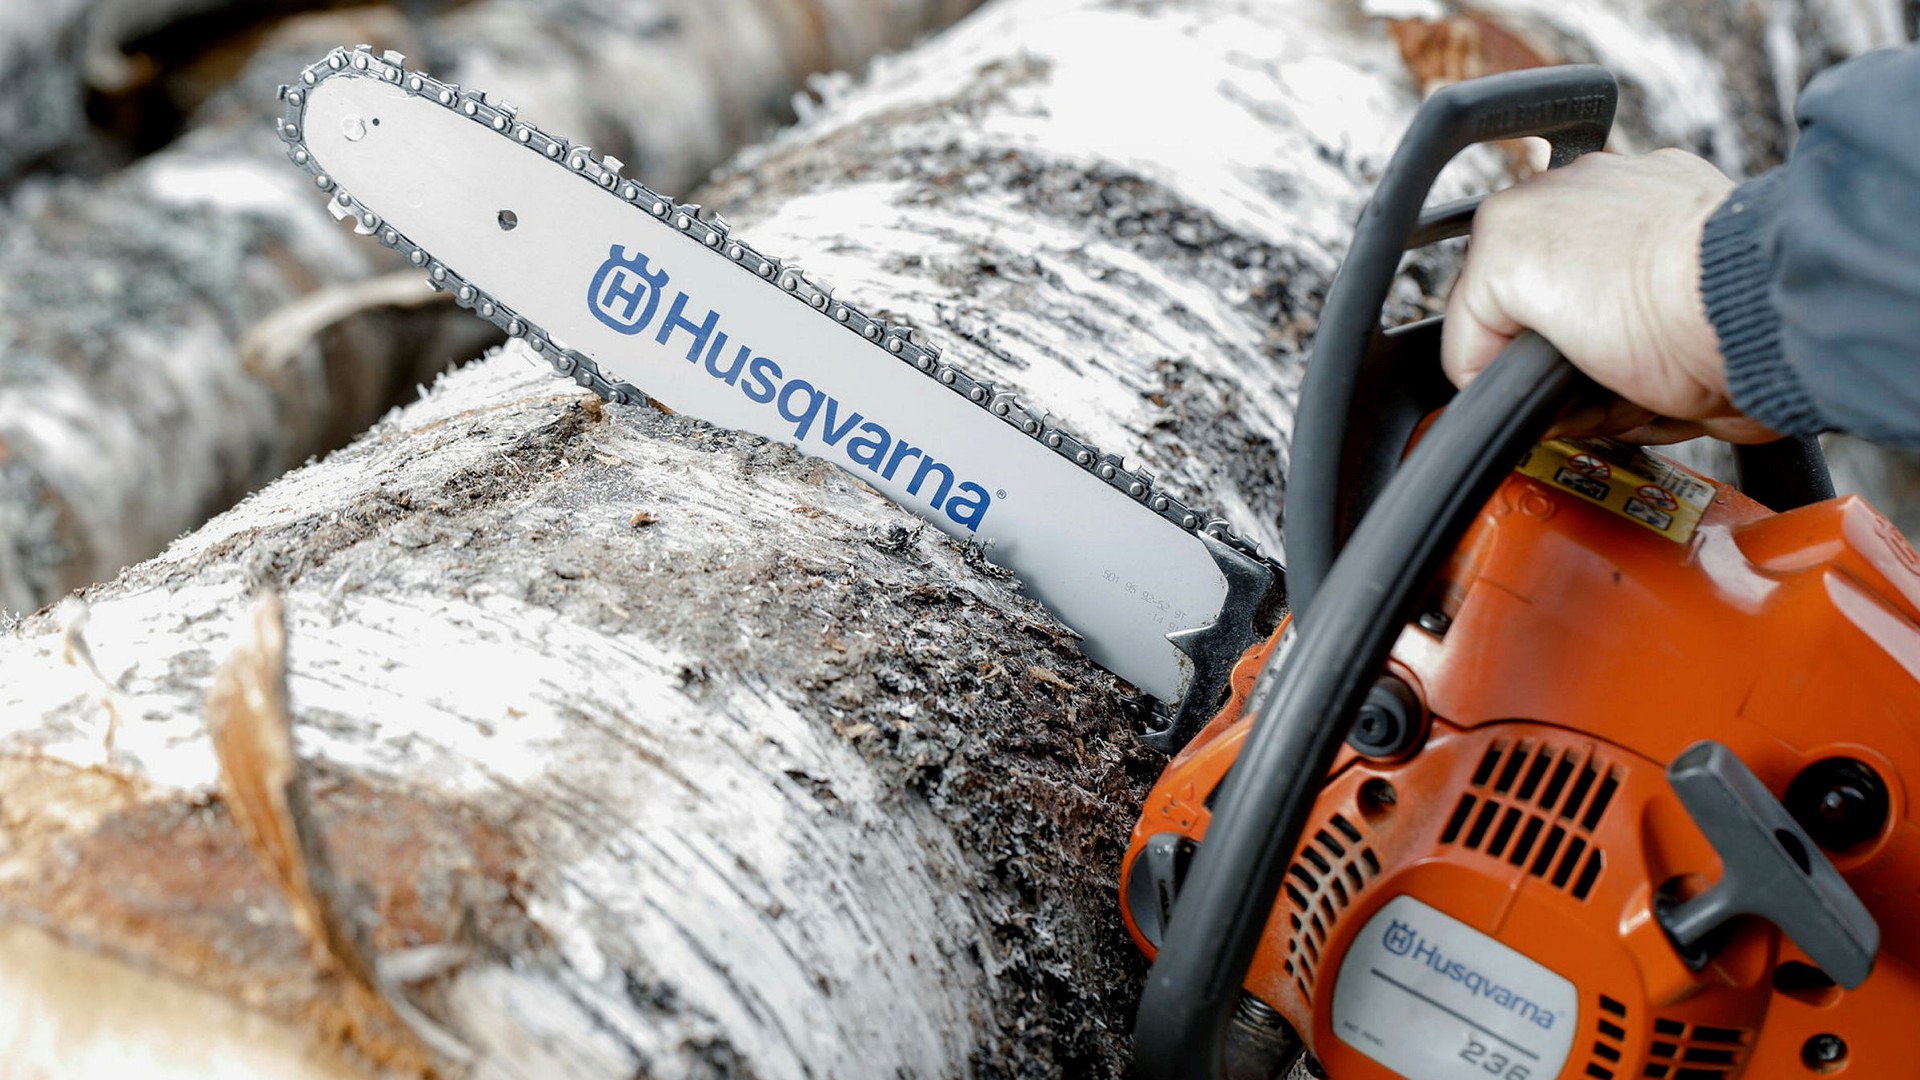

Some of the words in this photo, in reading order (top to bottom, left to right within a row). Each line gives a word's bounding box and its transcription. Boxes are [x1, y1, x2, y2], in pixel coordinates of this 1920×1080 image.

[655, 290, 990, 532] Husqvarna
[1102, 568, 1119, 584] 501
[1412, 938, 1555, 1030] Husqvarna
[1459, 1041, 1530, 1080] 236
